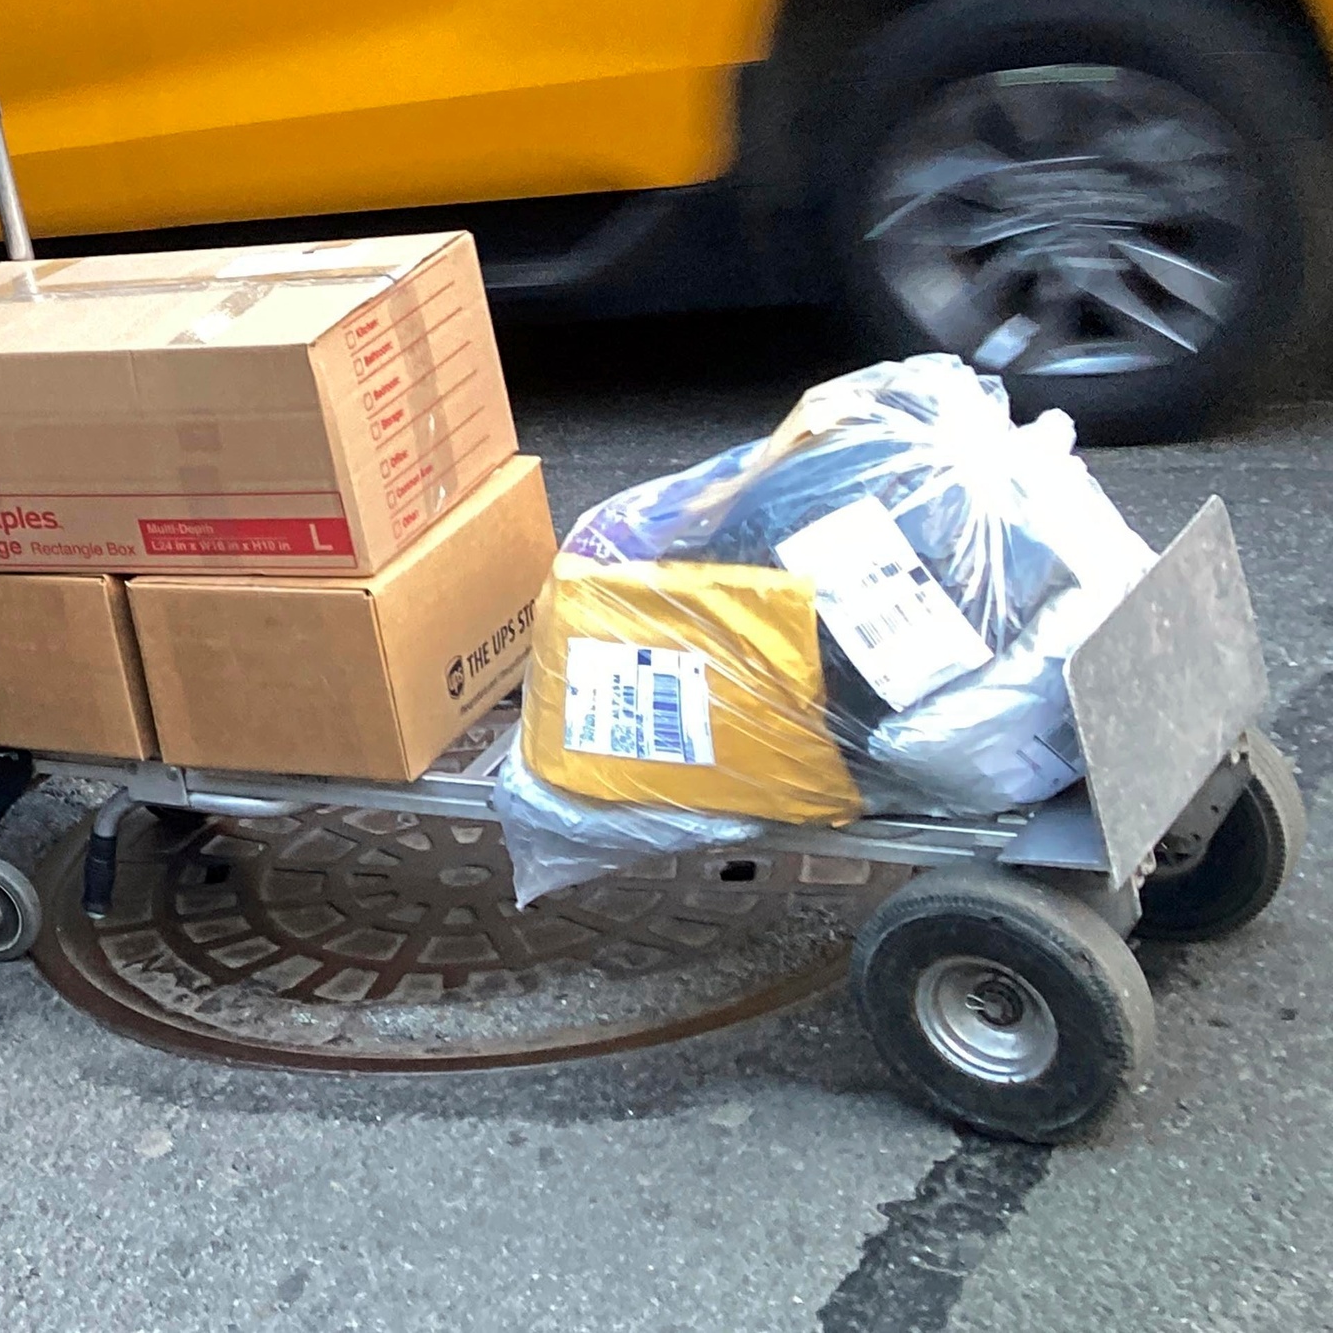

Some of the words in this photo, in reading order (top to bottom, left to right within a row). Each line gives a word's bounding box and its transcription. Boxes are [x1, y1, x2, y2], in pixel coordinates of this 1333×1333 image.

[30, 542, 103, 559] Rectangle
[106, 542, 136, 556] Box
[309, 523, 334, 551] L
[466, 642, 490, 677] THE
[492, 618, 516, 655] UPS
